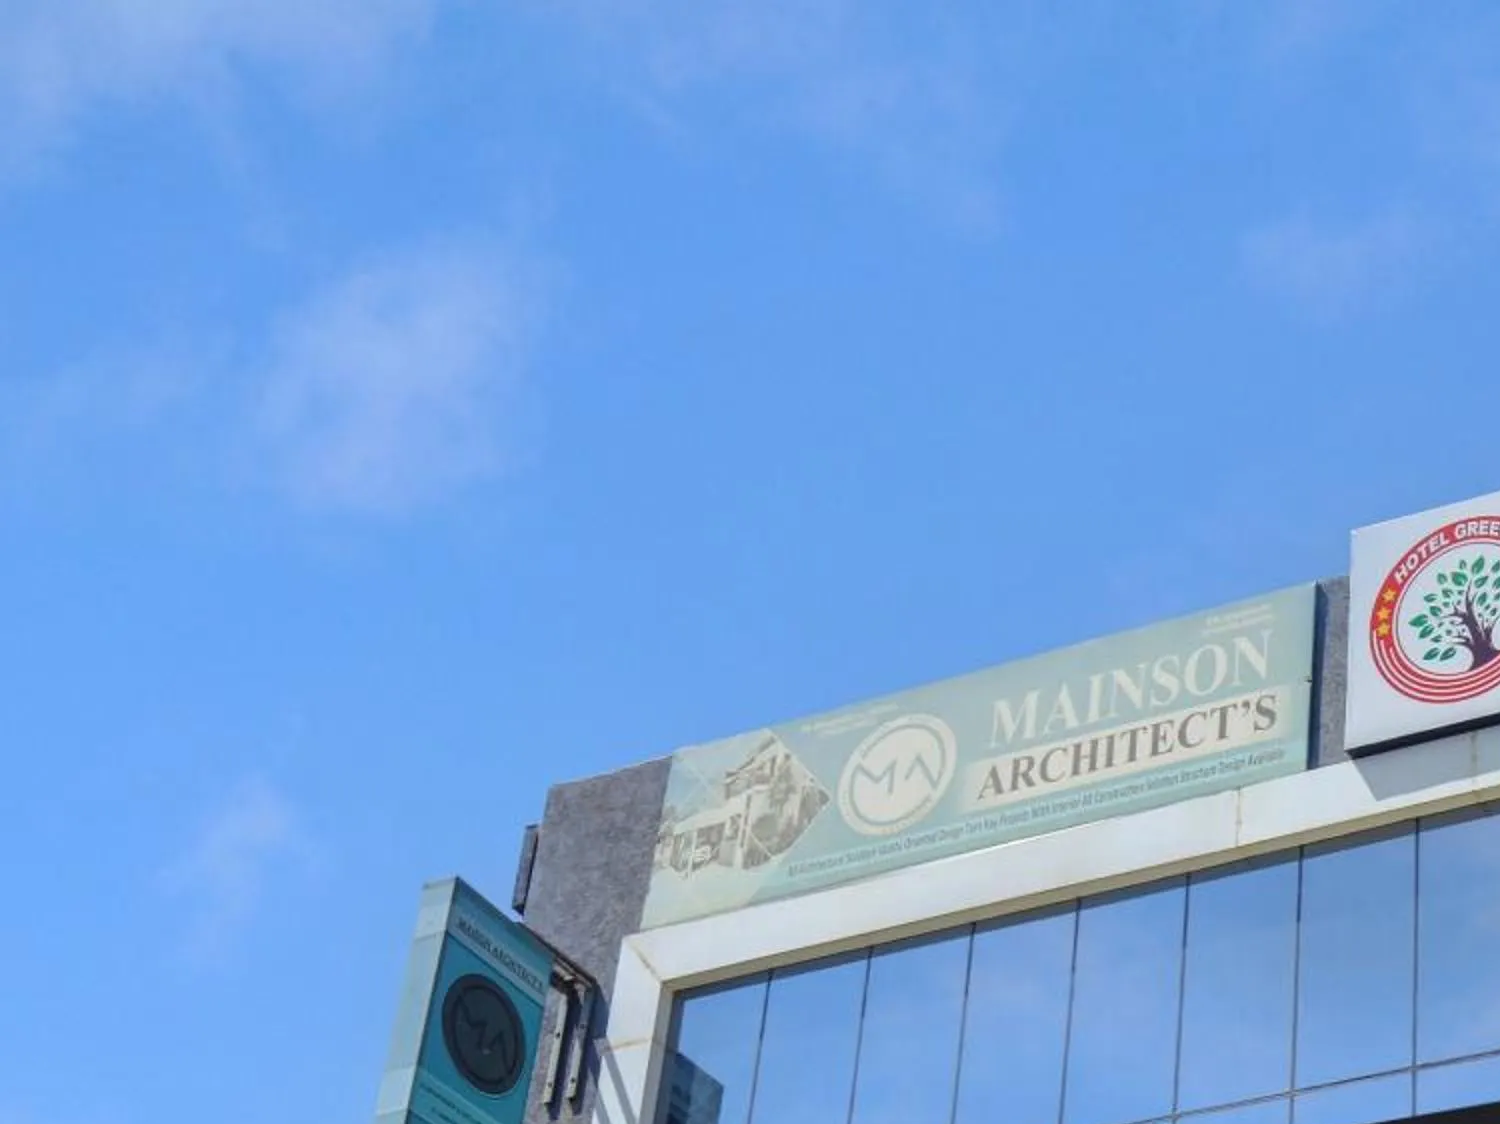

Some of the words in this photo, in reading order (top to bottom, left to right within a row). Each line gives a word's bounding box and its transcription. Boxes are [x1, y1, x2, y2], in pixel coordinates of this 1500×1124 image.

[1394, 533, 1451, 585] HOTEL
[989, 628, 1274, 749] MAINSON
[977, 693, 1279, 801] ARCHITECT'S
